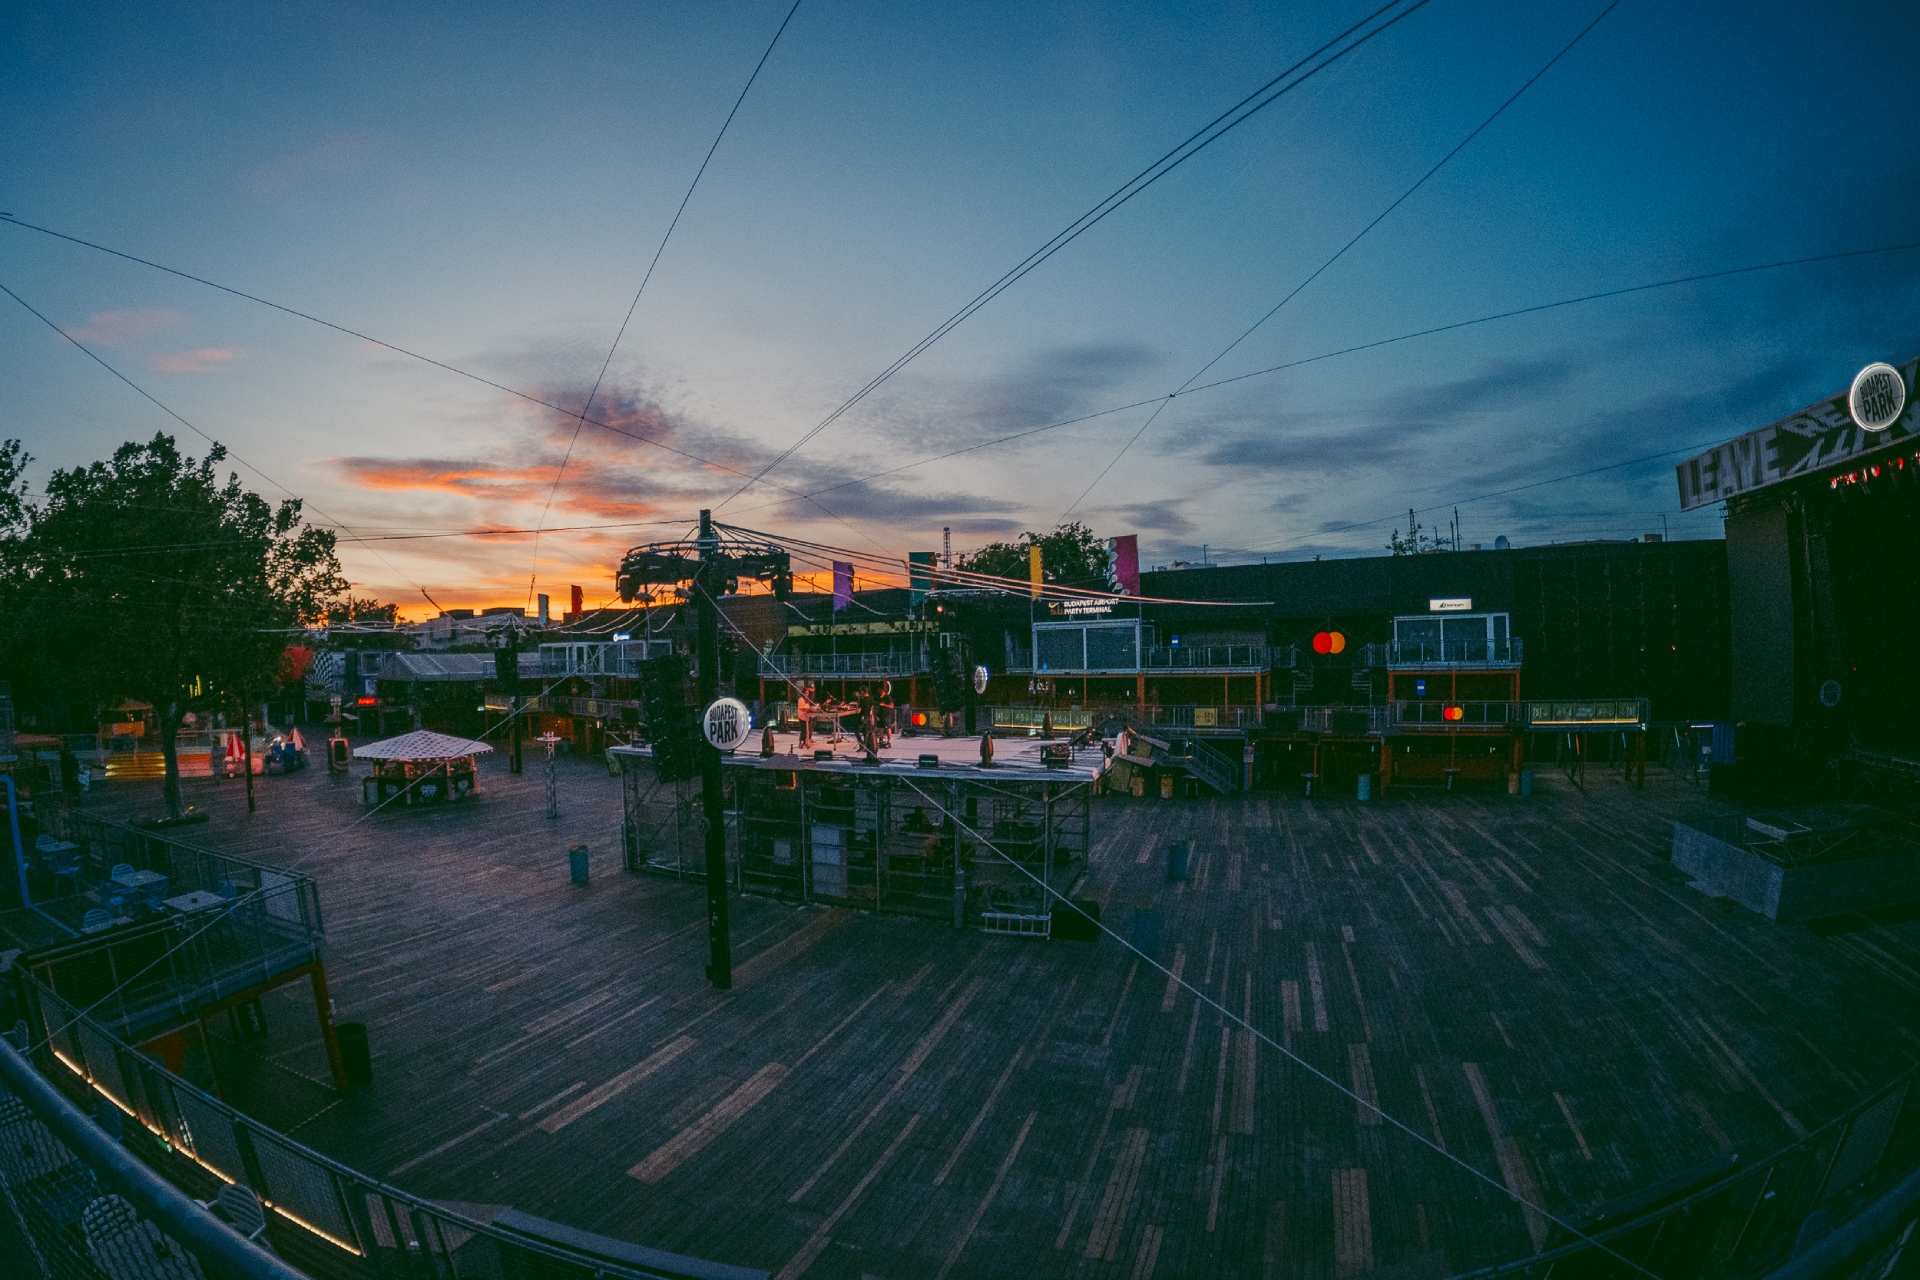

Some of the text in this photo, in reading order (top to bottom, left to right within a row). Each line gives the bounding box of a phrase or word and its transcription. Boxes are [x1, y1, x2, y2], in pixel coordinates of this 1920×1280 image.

[1860, 373, 1891, 400] BUDAPEST
[1863, 388, 1897, 422] PARK
[1083, 606, 1112, 614] TERMINAL
[1094, 598, 1119, 606] AIRPORT
[710, 704, 738, 721] BUDAPEST
[710, 720, 738, 743] PARK
